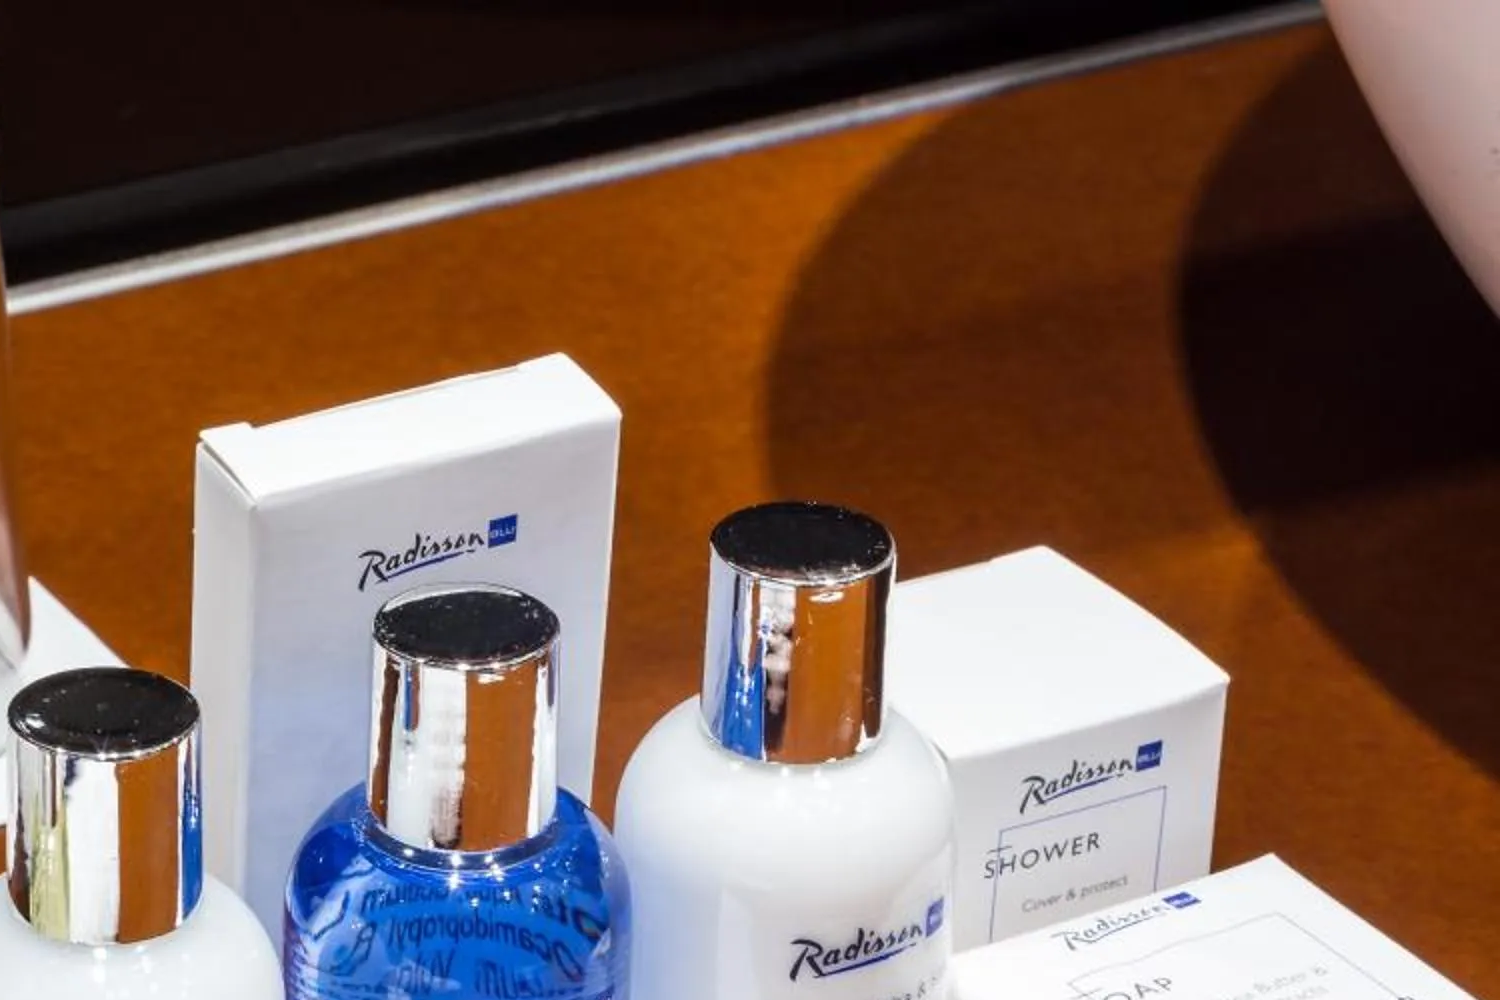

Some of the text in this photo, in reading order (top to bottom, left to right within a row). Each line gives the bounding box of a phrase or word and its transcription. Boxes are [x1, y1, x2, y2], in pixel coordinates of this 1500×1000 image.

[357, 533, 485, 592] Radisson
[1019, 759, 1133, 814] Radisson
[984, 832, 1100, 879] SHOWER
[1021, 875, 1129, 913] Cover & protect
[1050, 905, 1171, 951] Radisson
[789, 927, 923, 981] Radisson
